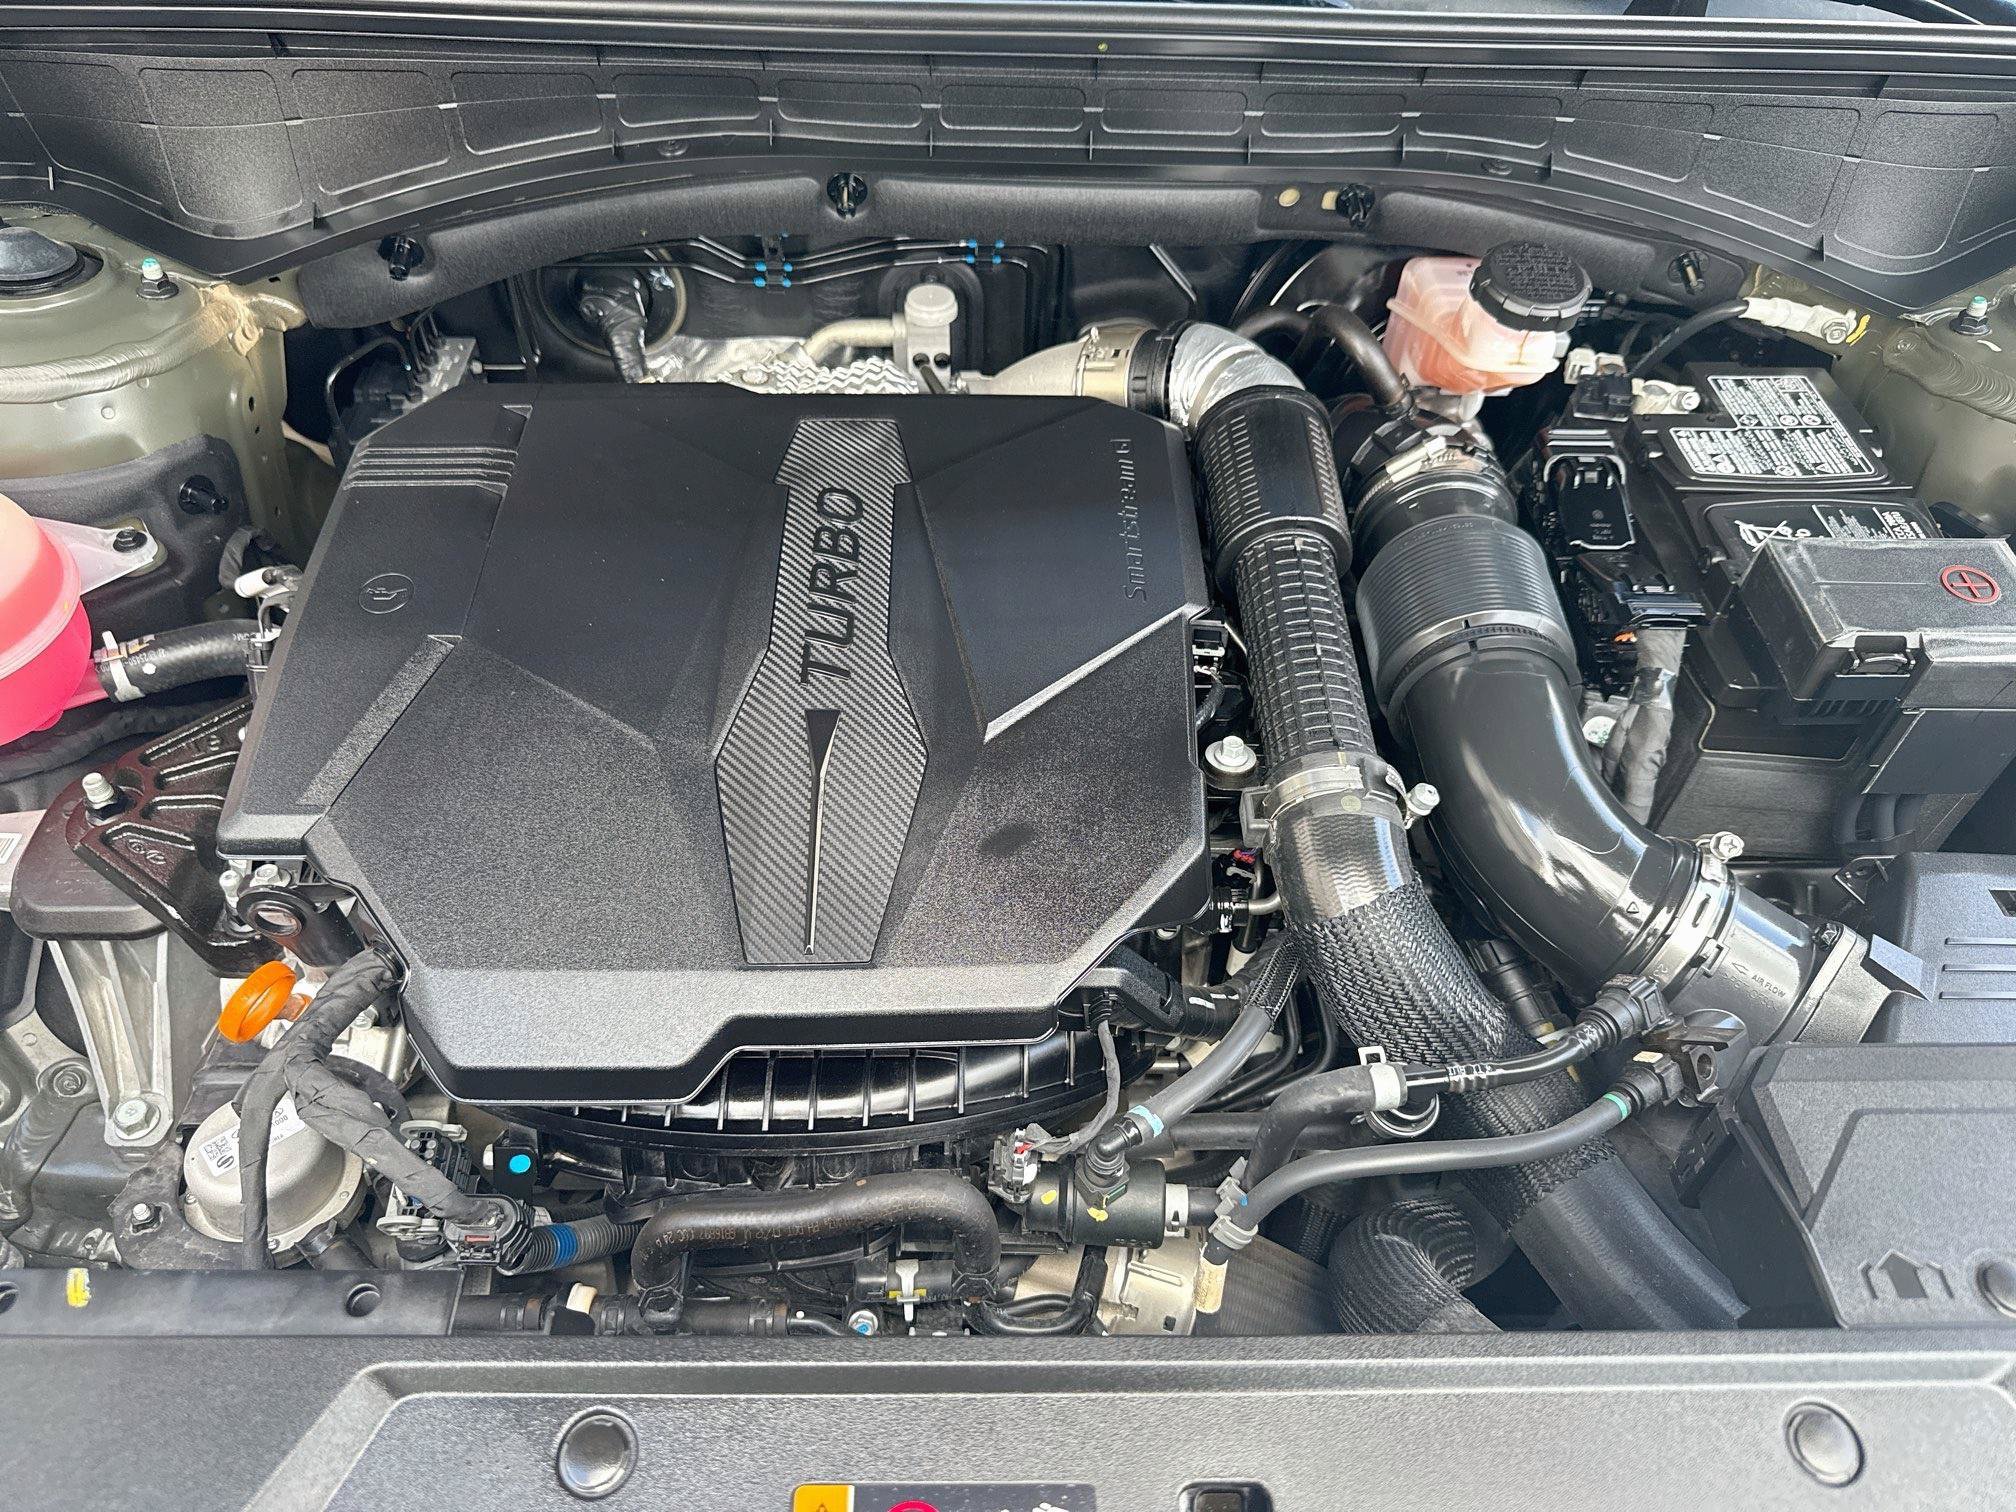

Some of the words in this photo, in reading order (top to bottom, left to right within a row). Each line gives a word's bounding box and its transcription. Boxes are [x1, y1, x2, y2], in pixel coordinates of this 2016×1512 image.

[799, 486, 864, 688] TURBO
[1116, 459, 1147, 603] Smartstream
[1751, 974, 1765, 987] AIR
[1764, 982, 1786, 999] FLOW
